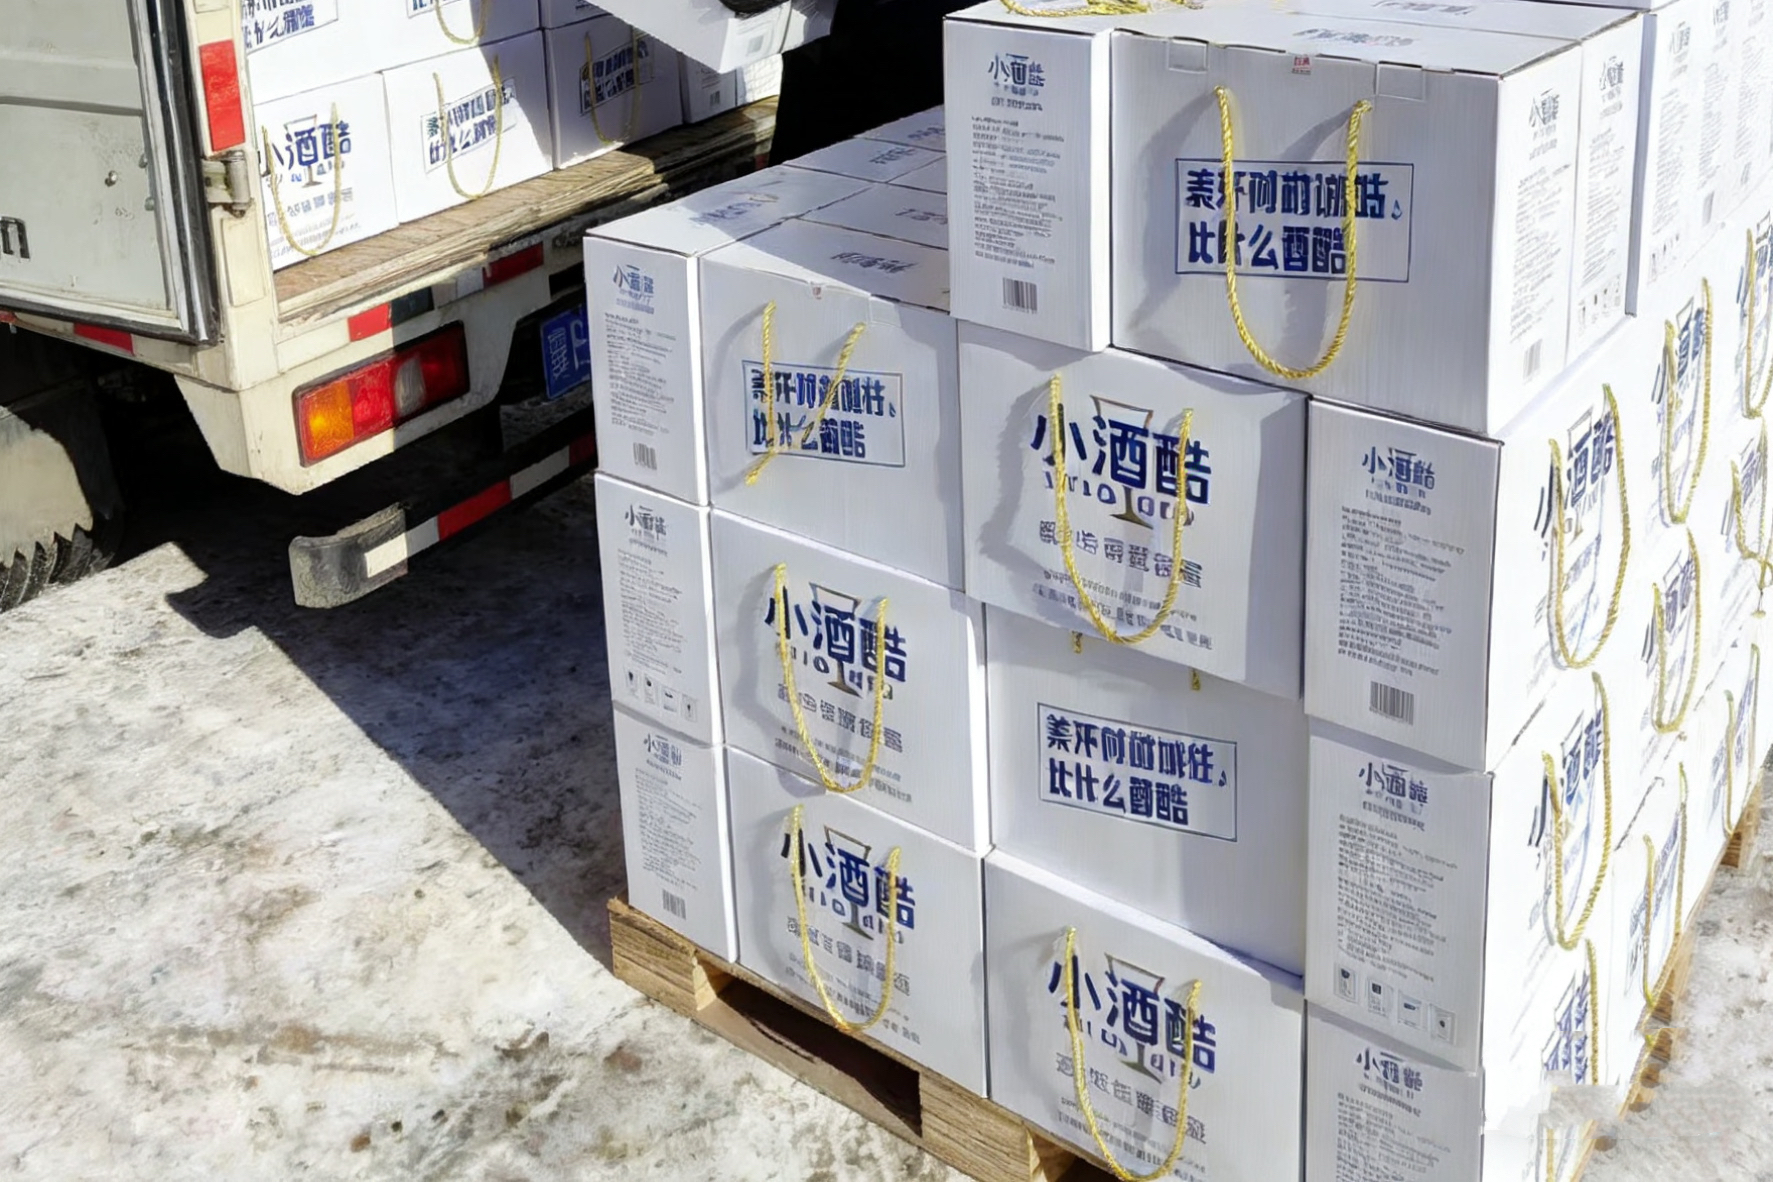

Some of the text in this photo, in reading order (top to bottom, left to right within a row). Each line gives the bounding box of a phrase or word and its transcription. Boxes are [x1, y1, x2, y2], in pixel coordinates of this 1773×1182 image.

[1030, 403, 1212, 506] 小酒酷
[764, 586, 907, 683] 小酒酷
[781, 828, 916, 930] 小酒酷
[1048, 954, 1216, 1074] 小酒酷
